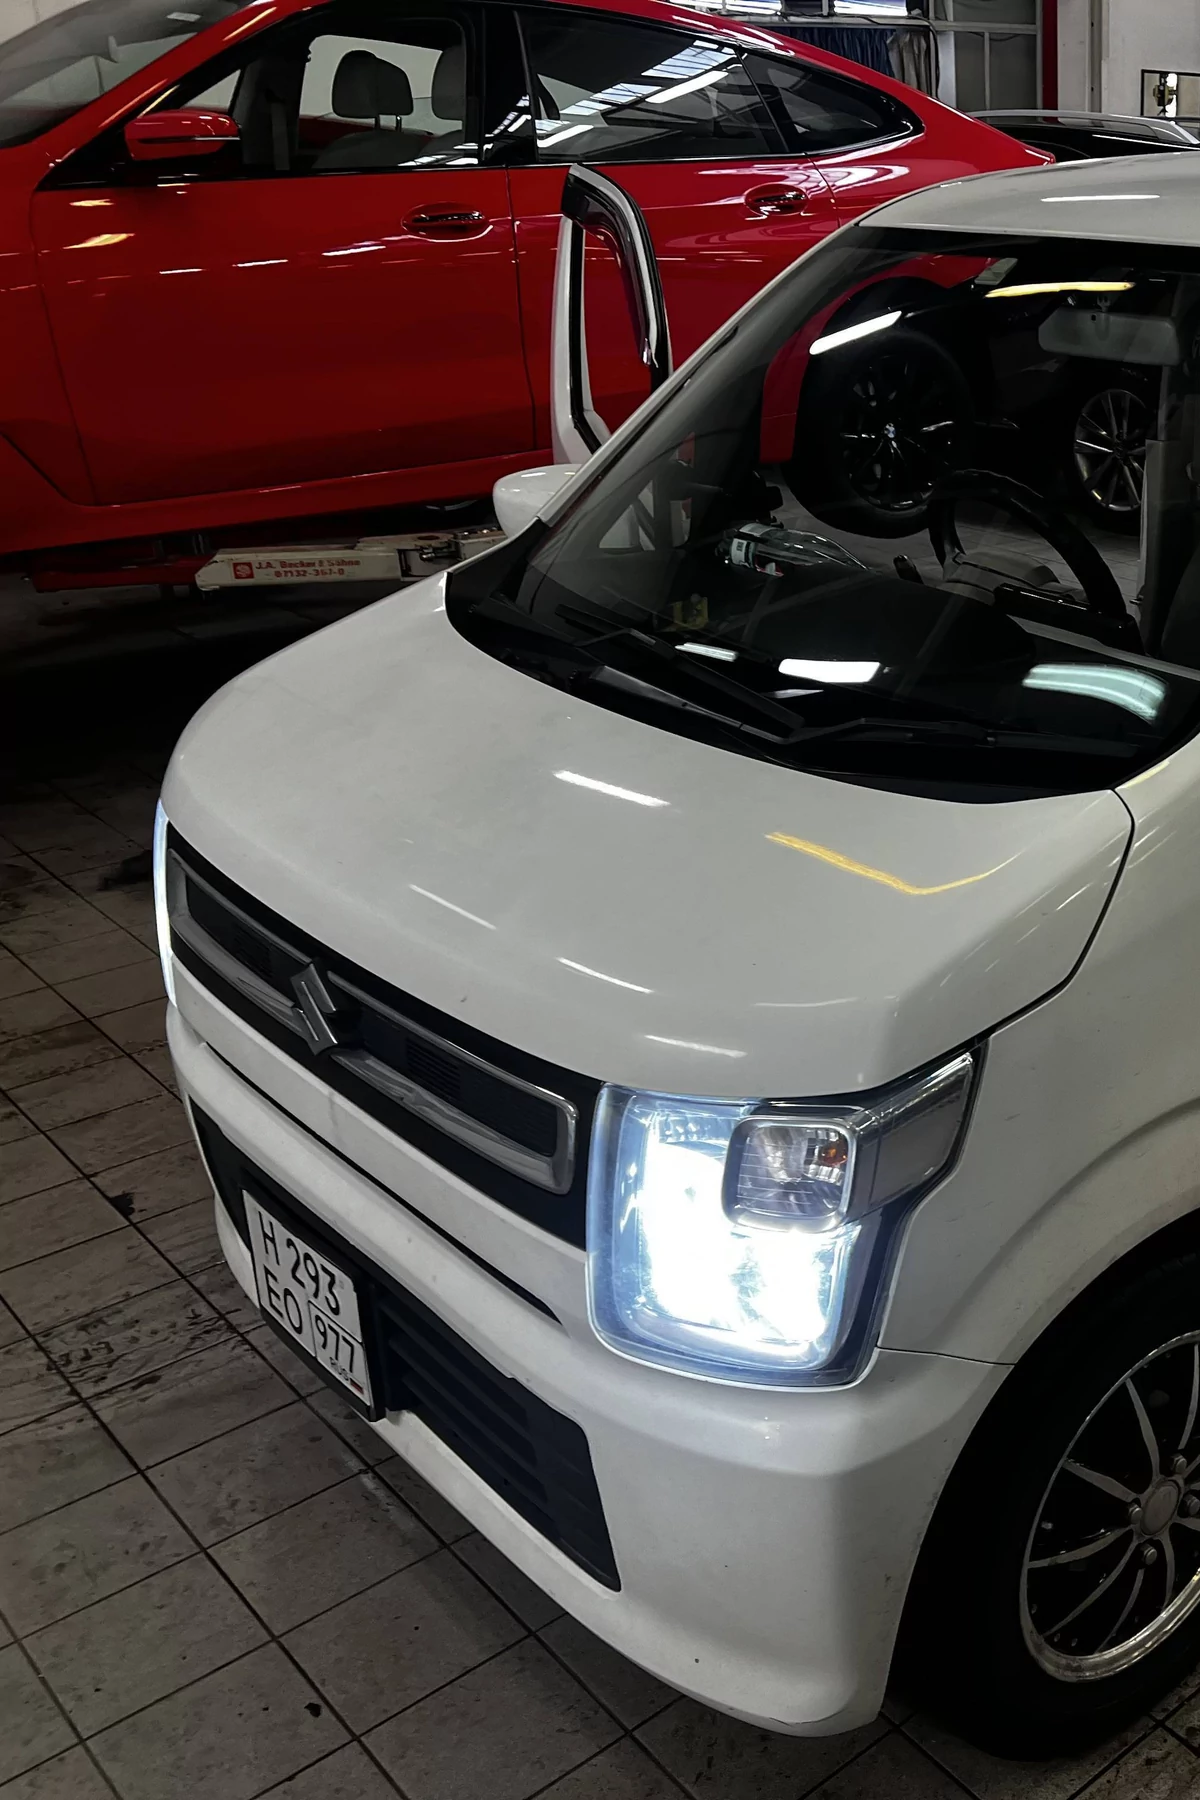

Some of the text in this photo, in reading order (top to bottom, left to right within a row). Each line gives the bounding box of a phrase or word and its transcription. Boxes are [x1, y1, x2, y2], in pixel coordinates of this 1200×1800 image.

[255, 561, 276, 570] J.A.
[286, 1237, 340, 1316] 293
[314, 1314, 355, 1374] 977
